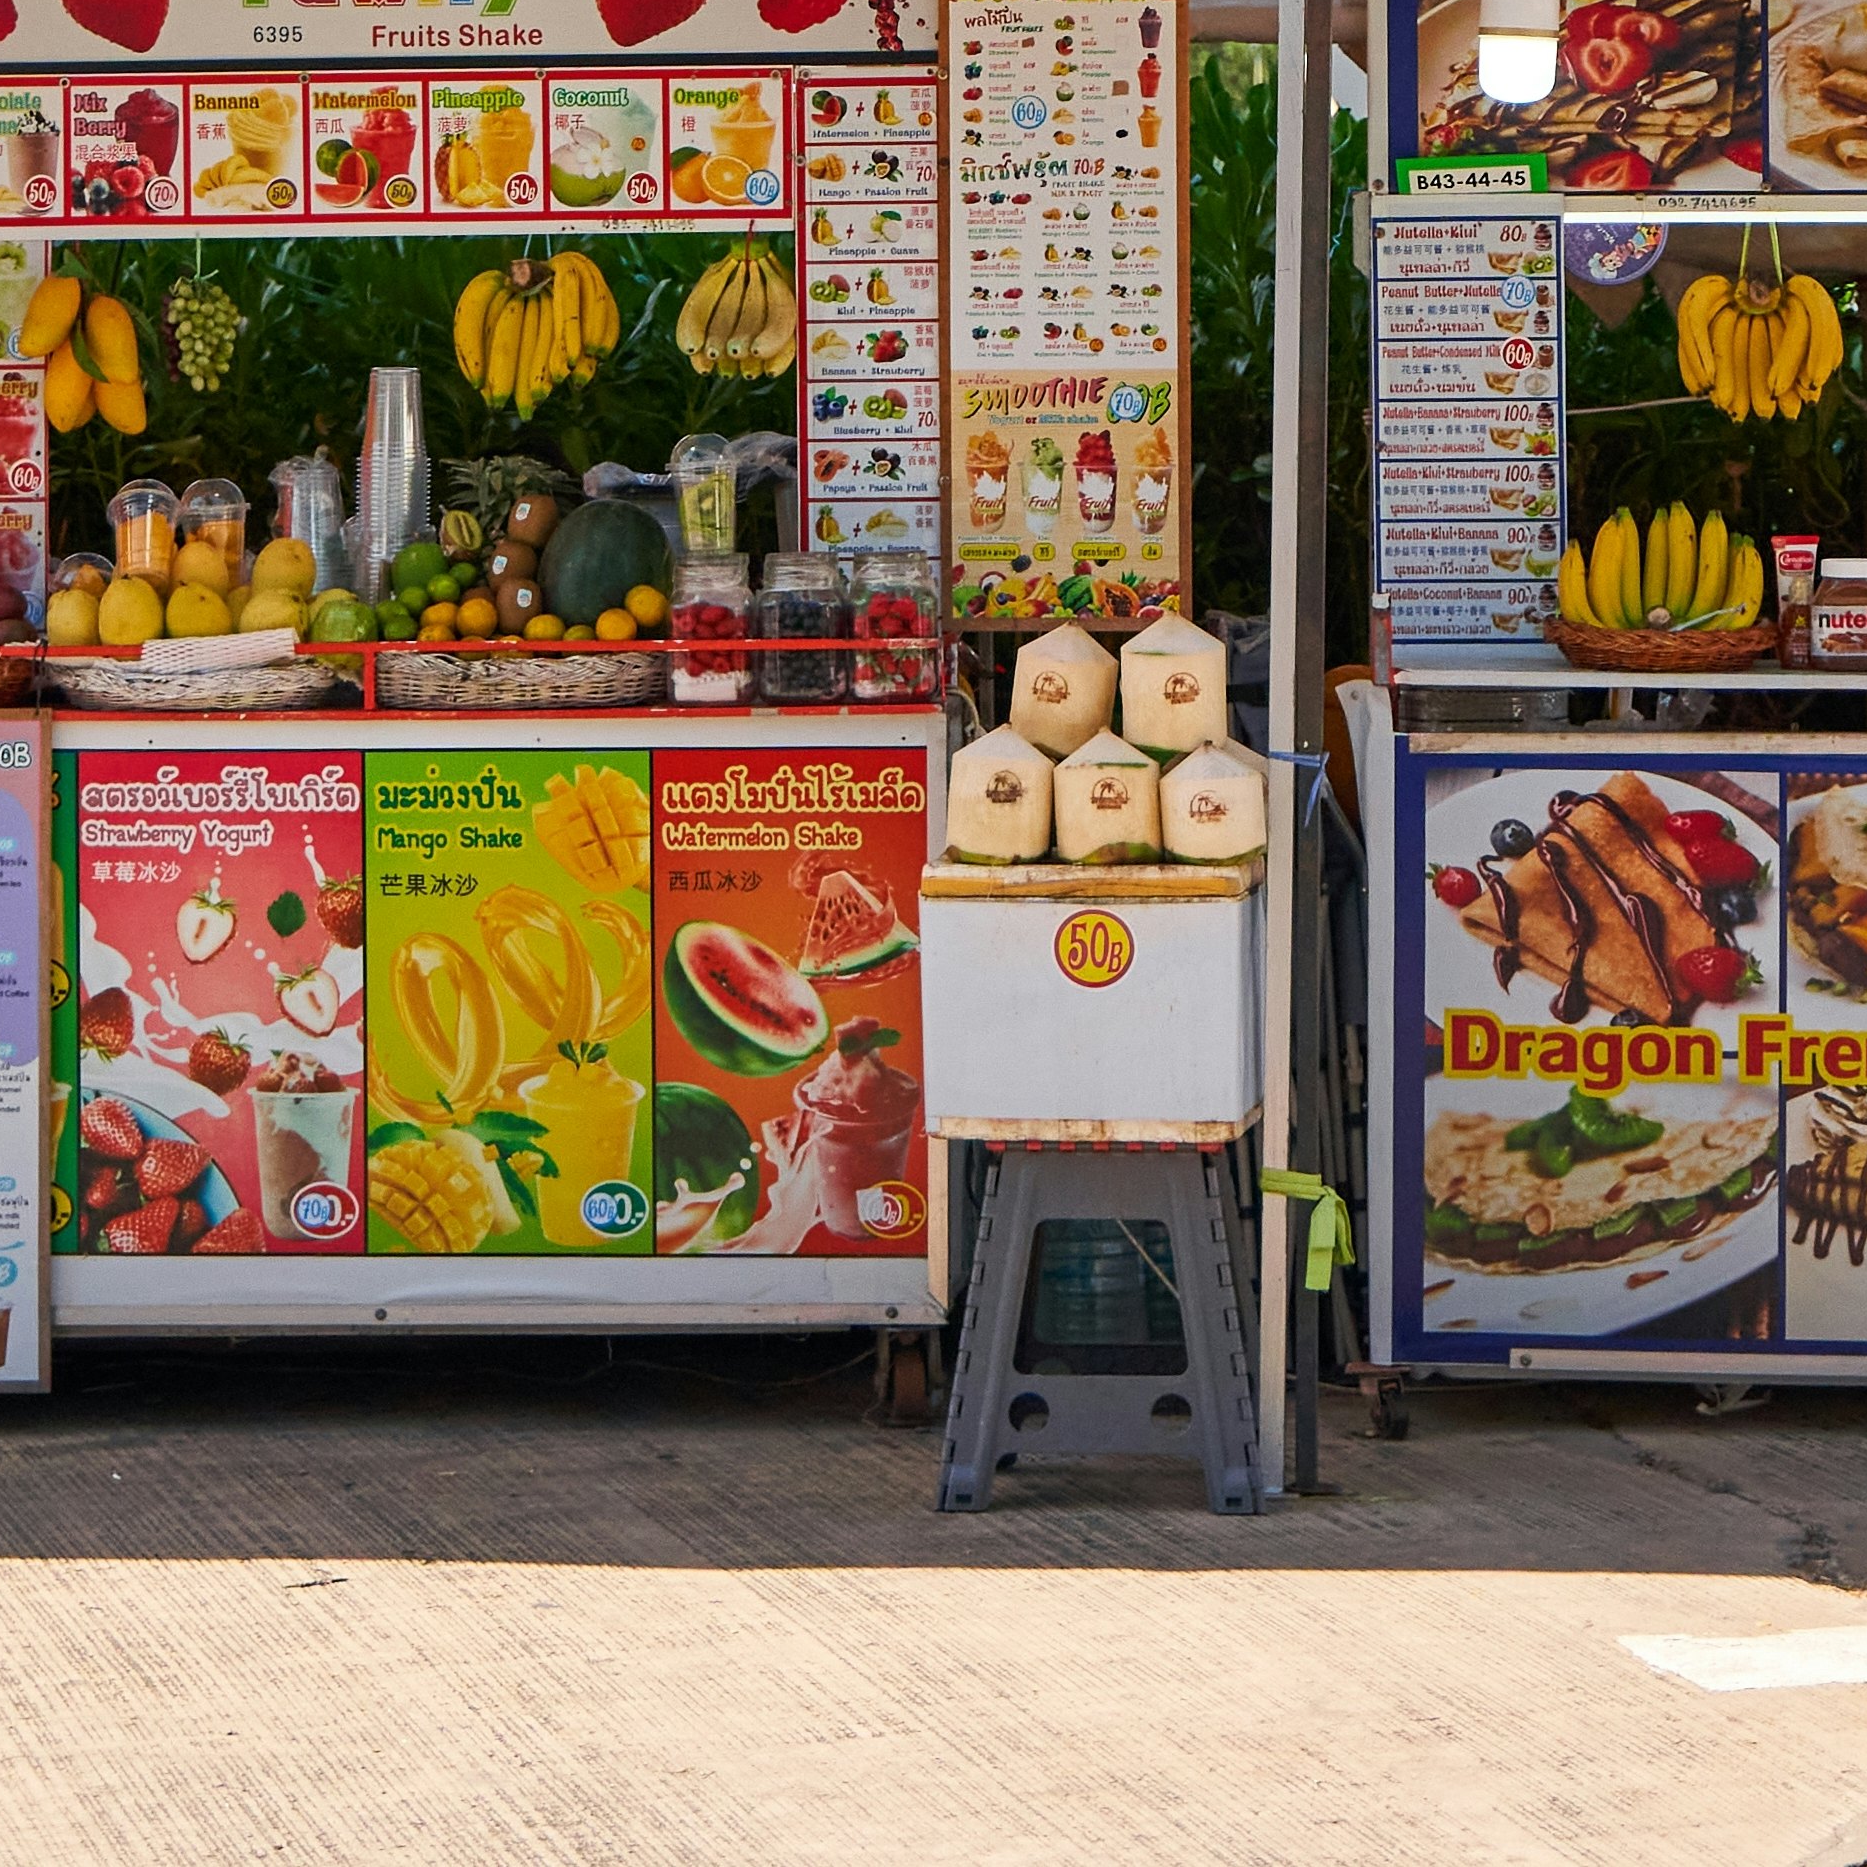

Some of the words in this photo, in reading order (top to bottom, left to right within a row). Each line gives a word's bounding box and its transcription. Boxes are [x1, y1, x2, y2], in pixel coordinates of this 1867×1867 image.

[253, 25, 303, 43] 6395
[372, 24, 450, 48] Fruits
[459, 23, 543, 46] Shake
[74, 94, 107, 113] Mix
[194, 93, 260, 111] Banana
[312, 92, 416, 110] Watermelon
[432, 88, 525, 113] Pineapple
[553, 88, 629, 107] Coconut
[674, 88, 740, 108] Orange
[74, 119, 126, 141] Berry
[315, 118, 345, 134] 西瓜
[554, 114, 585, 131] 椰子
[196, 123, 226, 141] 香蕉
[813, 129, 869, 138] Watermelon
[883, 129, 930, 139] Pineapple
[1417, 171, 1526, 190] B43-44-45
[819, 189, 851, 197] Mango
[865, 188, 901, 196] Passion
[906, 188, 928, 196] Fruit
[829, 247, 876, 257] Pineapple
[891, 247, 919, 255] Guava
[1382, 285, 1419, 298] Peanut
[837, 307, 856, 316] Kiwi
[869, 306, 915, 317] Pineapple
[1506, 344, 1531, 365] 60B
[871, 367, 925, 376] Strawberry
[962, 377, 1108, 418] SMOOTHIE
[834, 426, 881, 436] Blueberry
[894, 426, 913, 434] Kiwi
[823, 484, 856, 493] Papaya
[869, 483, 904, 492] Passion
[907, 484, 928, 492] Fruit
[975, 497, 1004, 509] Fruit
[1028, 497, 1058, 508] Fruit
[1084, 499, 1111, 510] Fruit
[1137, 500, 1164, 510] Fruit
[378, 767, 522, 811] มะม่วงปั่น
[85, 825, 194, 849] Strawberry
[205, 824, 272, 851] Yogurt
[378, 828, 448, 856] Mango
[460, 827, 523, 850] Shake
[666, 825, 786, 847] Watermelon
[798, 825, 858, 847] Shake
[92, 860, 182, 883] 草莓冰沙
[380, 873, 479, 897] 芒果冰沙
[669, 870, 763, 892] 西瓜冰沙
[1068, 922, 1123, 973] 50B
[1451, 1014, 1715, 1089] Dragon
